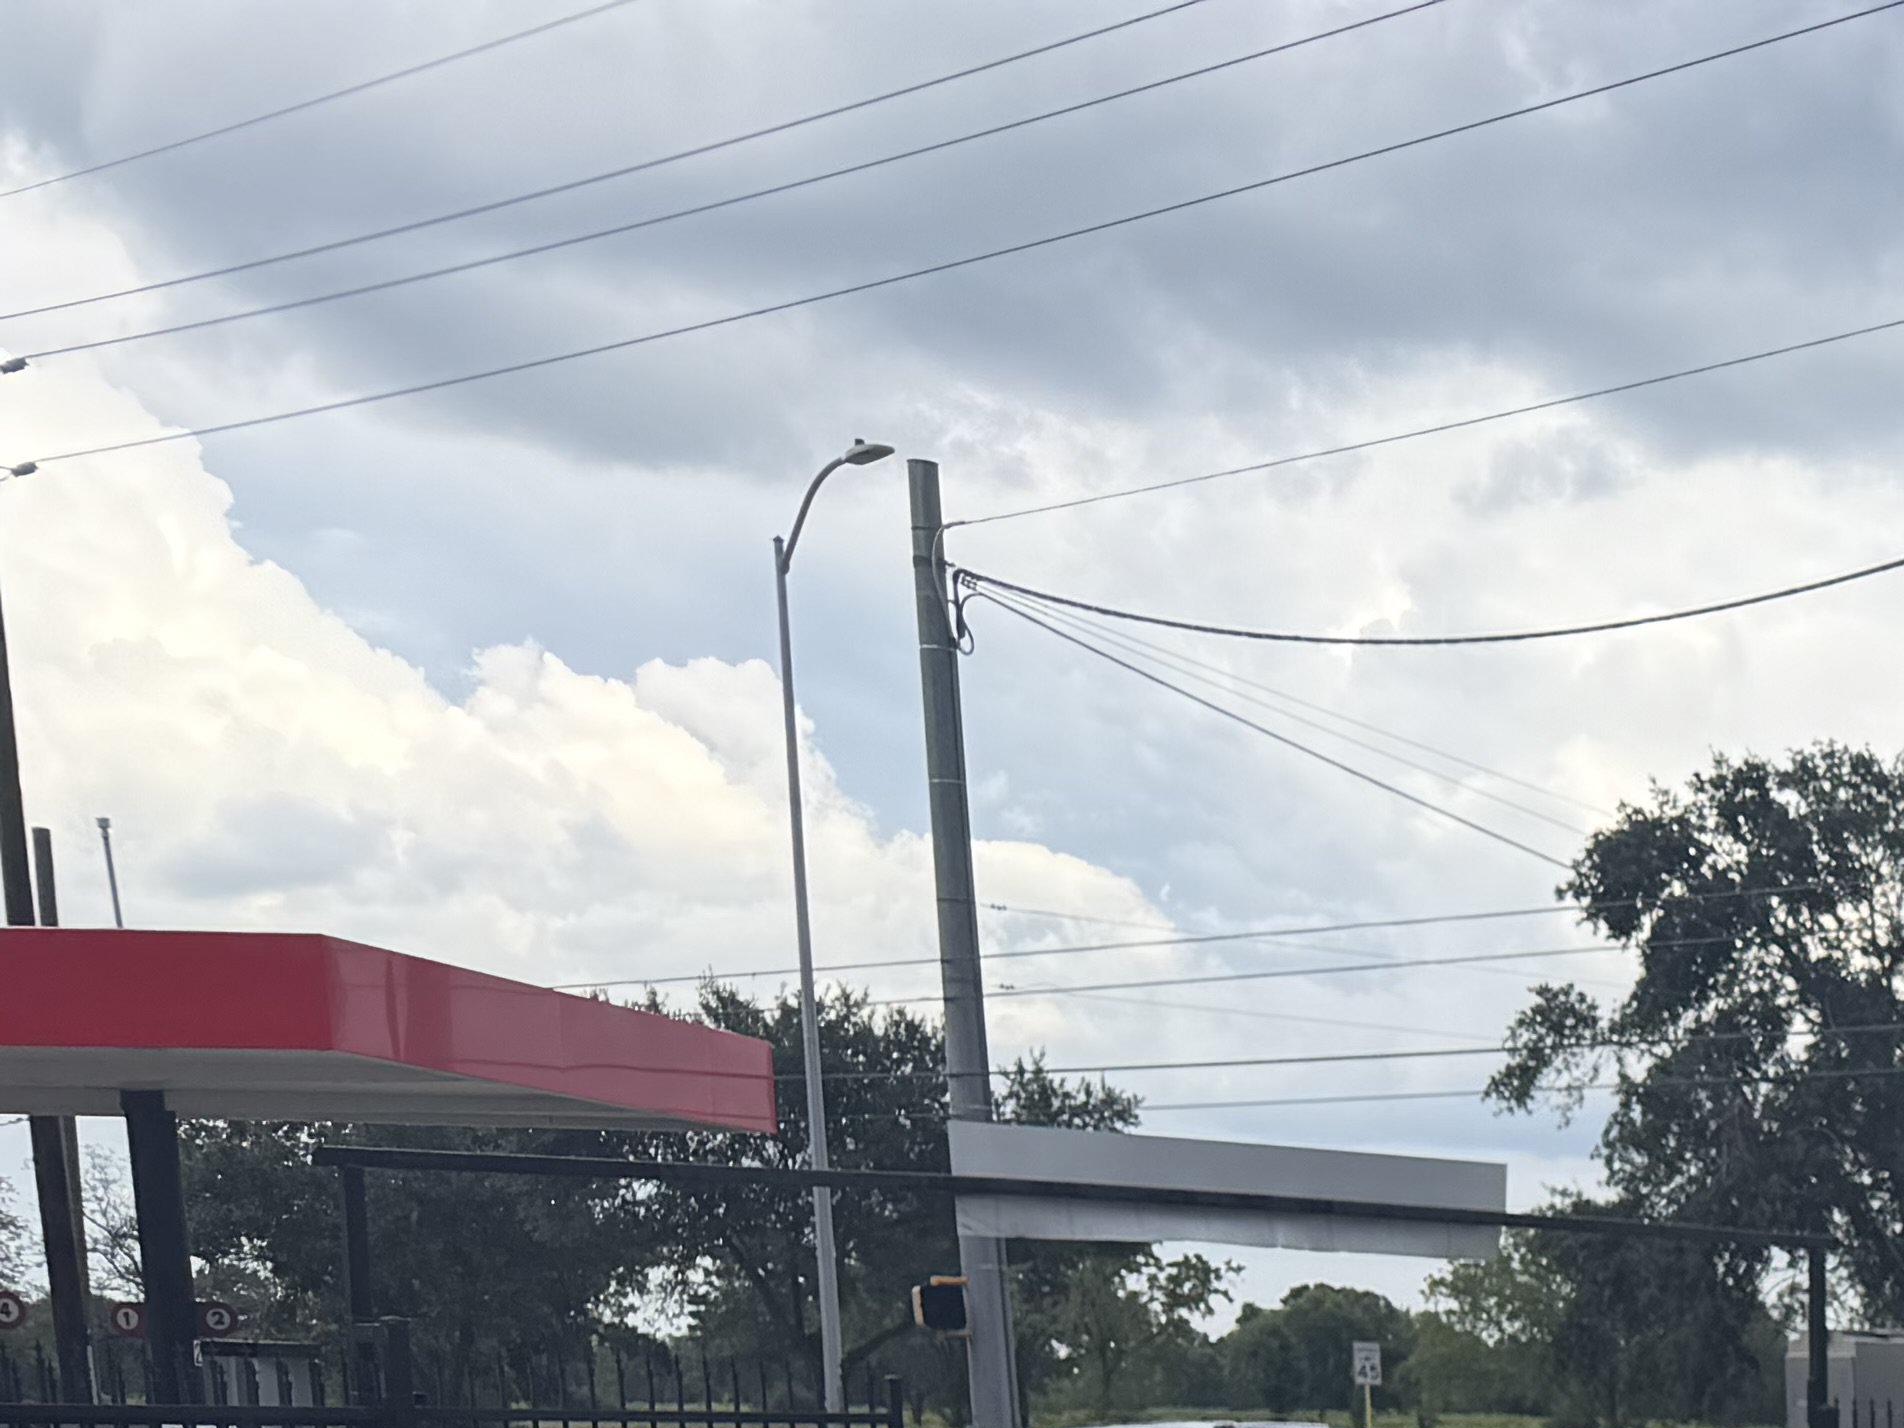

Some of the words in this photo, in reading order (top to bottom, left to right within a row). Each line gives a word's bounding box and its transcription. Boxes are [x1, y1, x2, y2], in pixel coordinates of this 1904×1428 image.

[0, 1303, 10, 1318] 4
[123, 1312, 131, 1326] 1
[211, 1311, 225, 1326] 2
